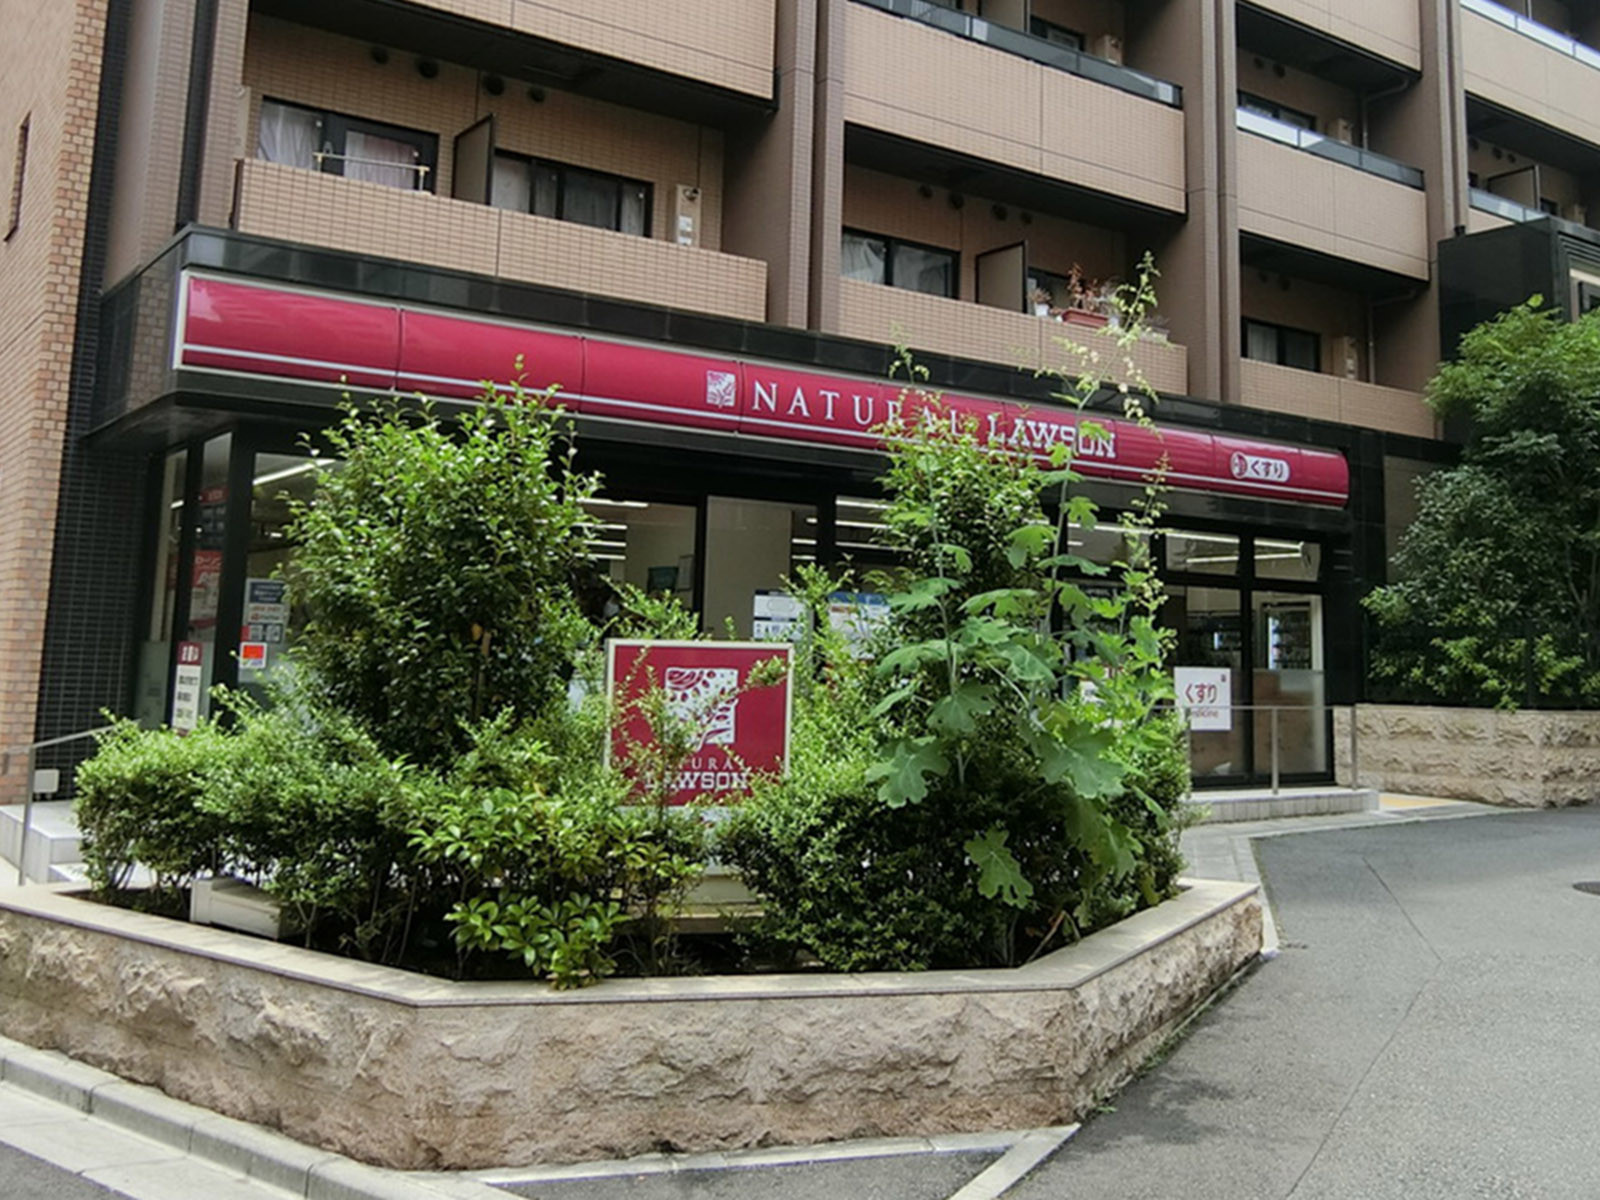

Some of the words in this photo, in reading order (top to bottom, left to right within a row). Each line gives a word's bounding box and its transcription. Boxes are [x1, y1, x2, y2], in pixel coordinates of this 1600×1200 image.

[1250, 459, 1284, 479] くすり
[1184, 682, 1218, 704] くすり
